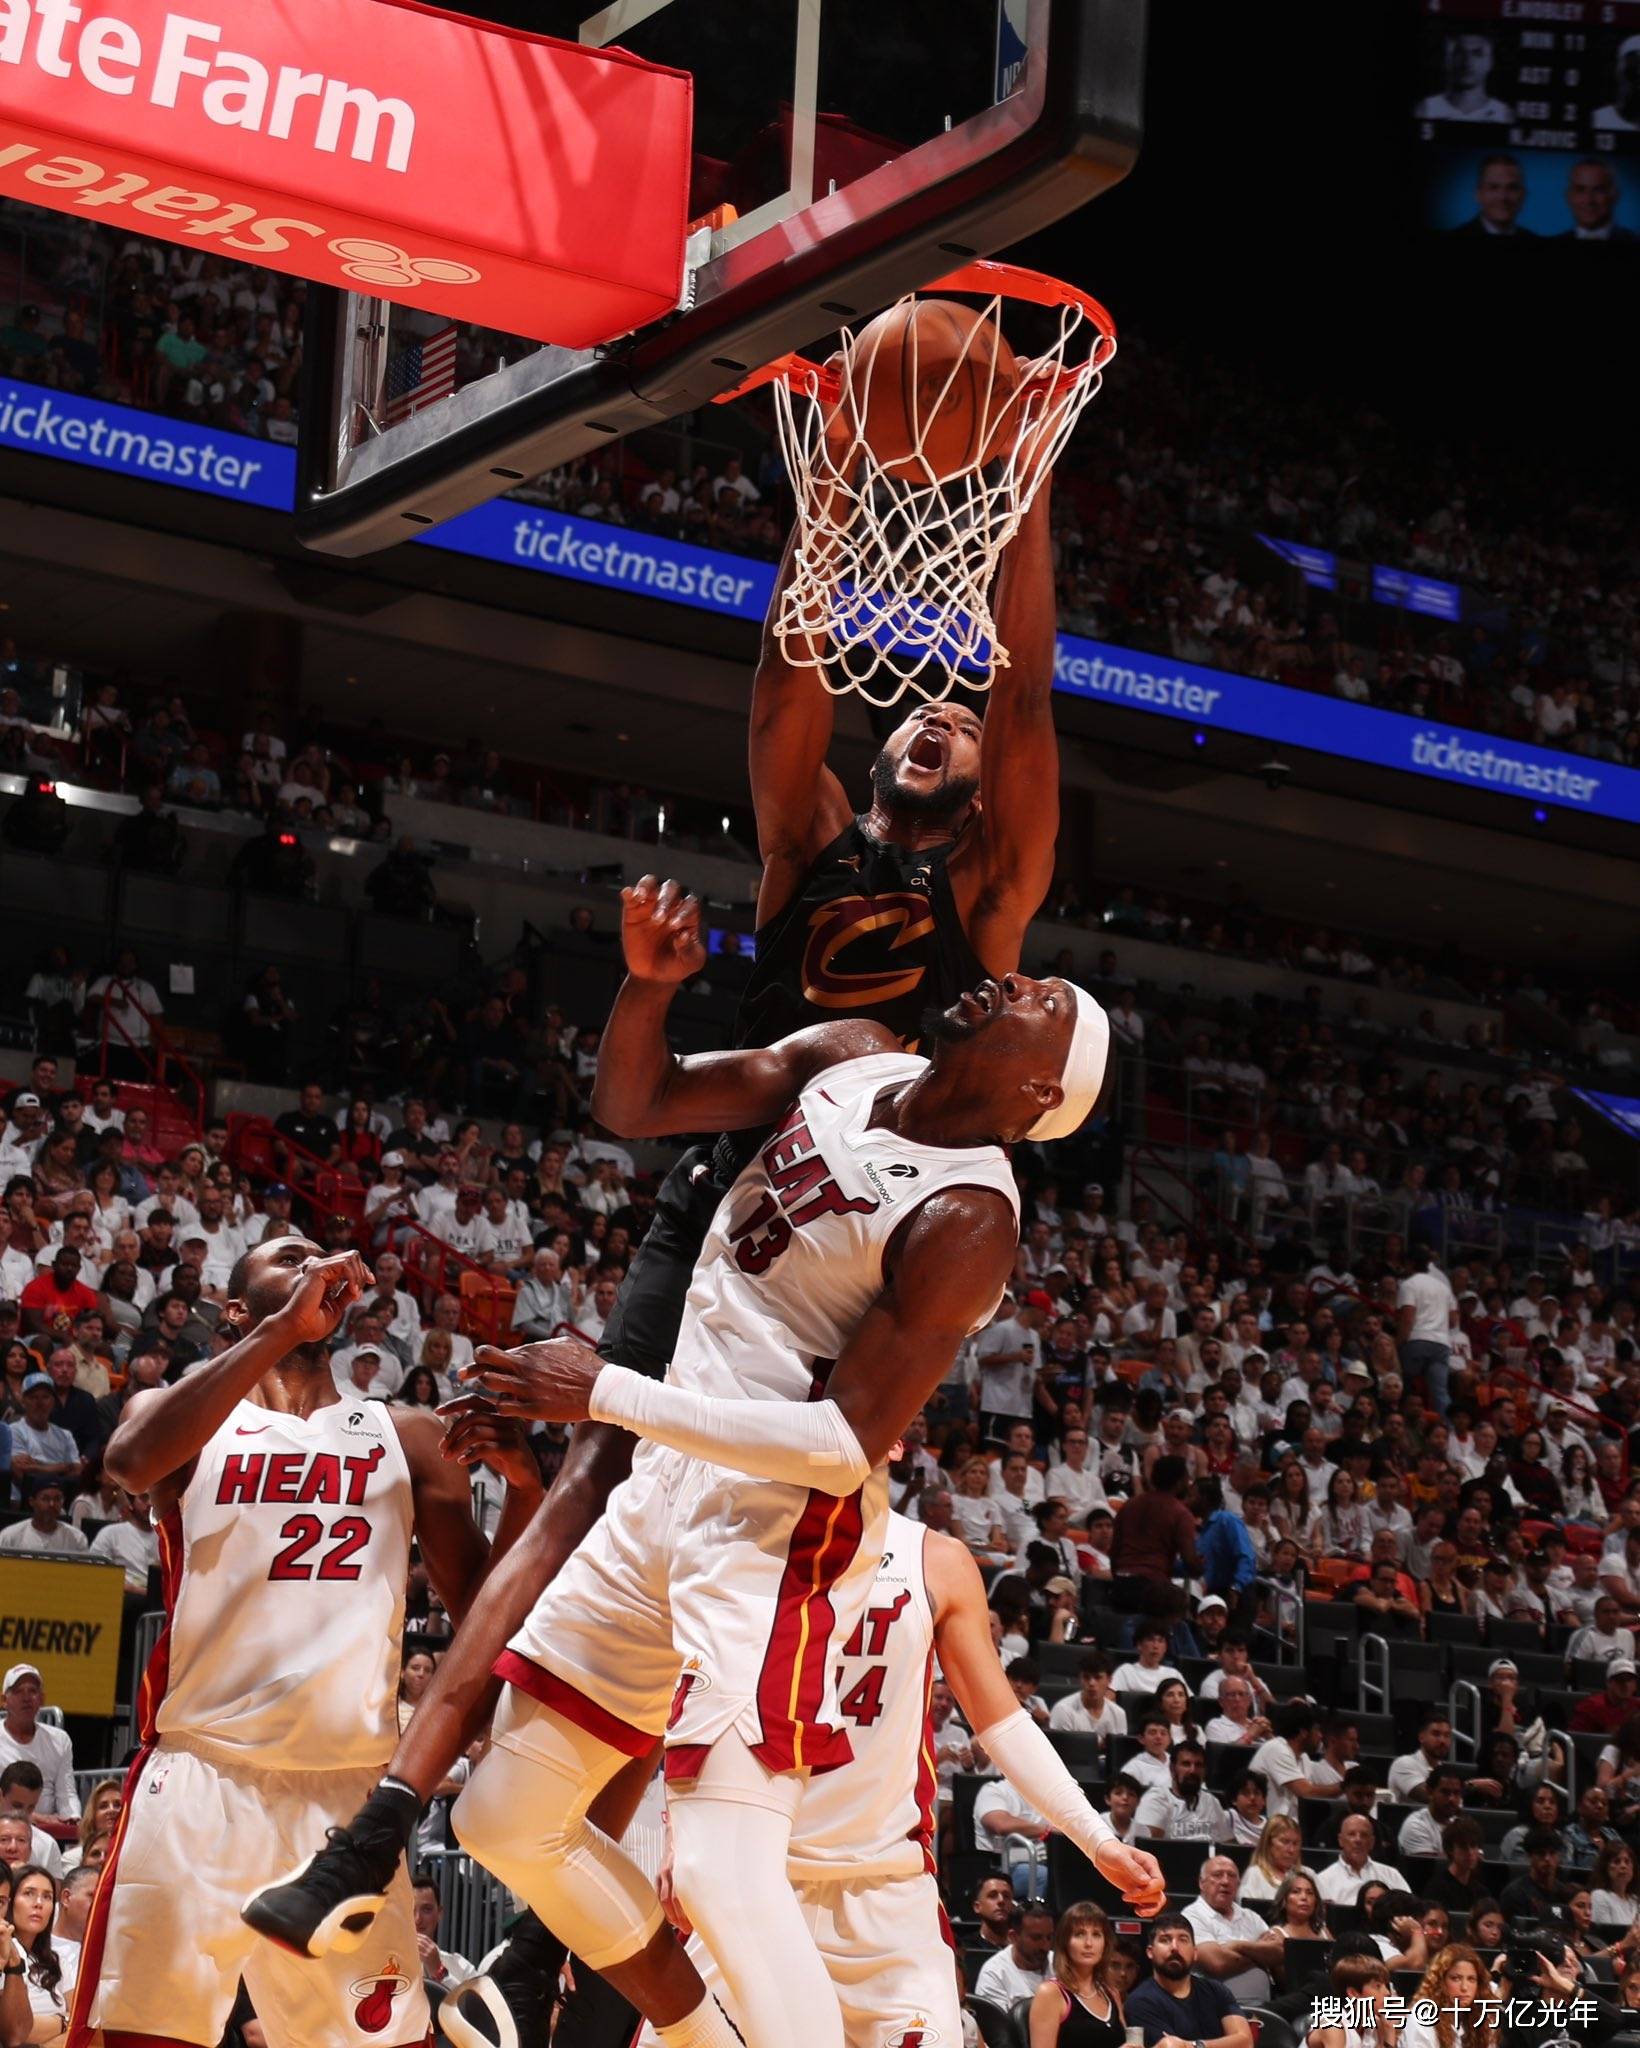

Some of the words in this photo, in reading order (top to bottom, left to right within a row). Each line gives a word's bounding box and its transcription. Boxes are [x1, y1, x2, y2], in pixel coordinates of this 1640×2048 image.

[512, 519, 754, 606] ticketmaster
[1411, 731, 1600, 802] ticketmaster
[862, 1161, 896, 1206] Robinhood
[729, 1190, 793, 1276] 13
[215, 1442, 386, 1506] HEAT
[267, 1513, 373, 1581] 22
[0, 1616, 102, 1657] ENERGY
[835, 1664, 889, 1728] 4
